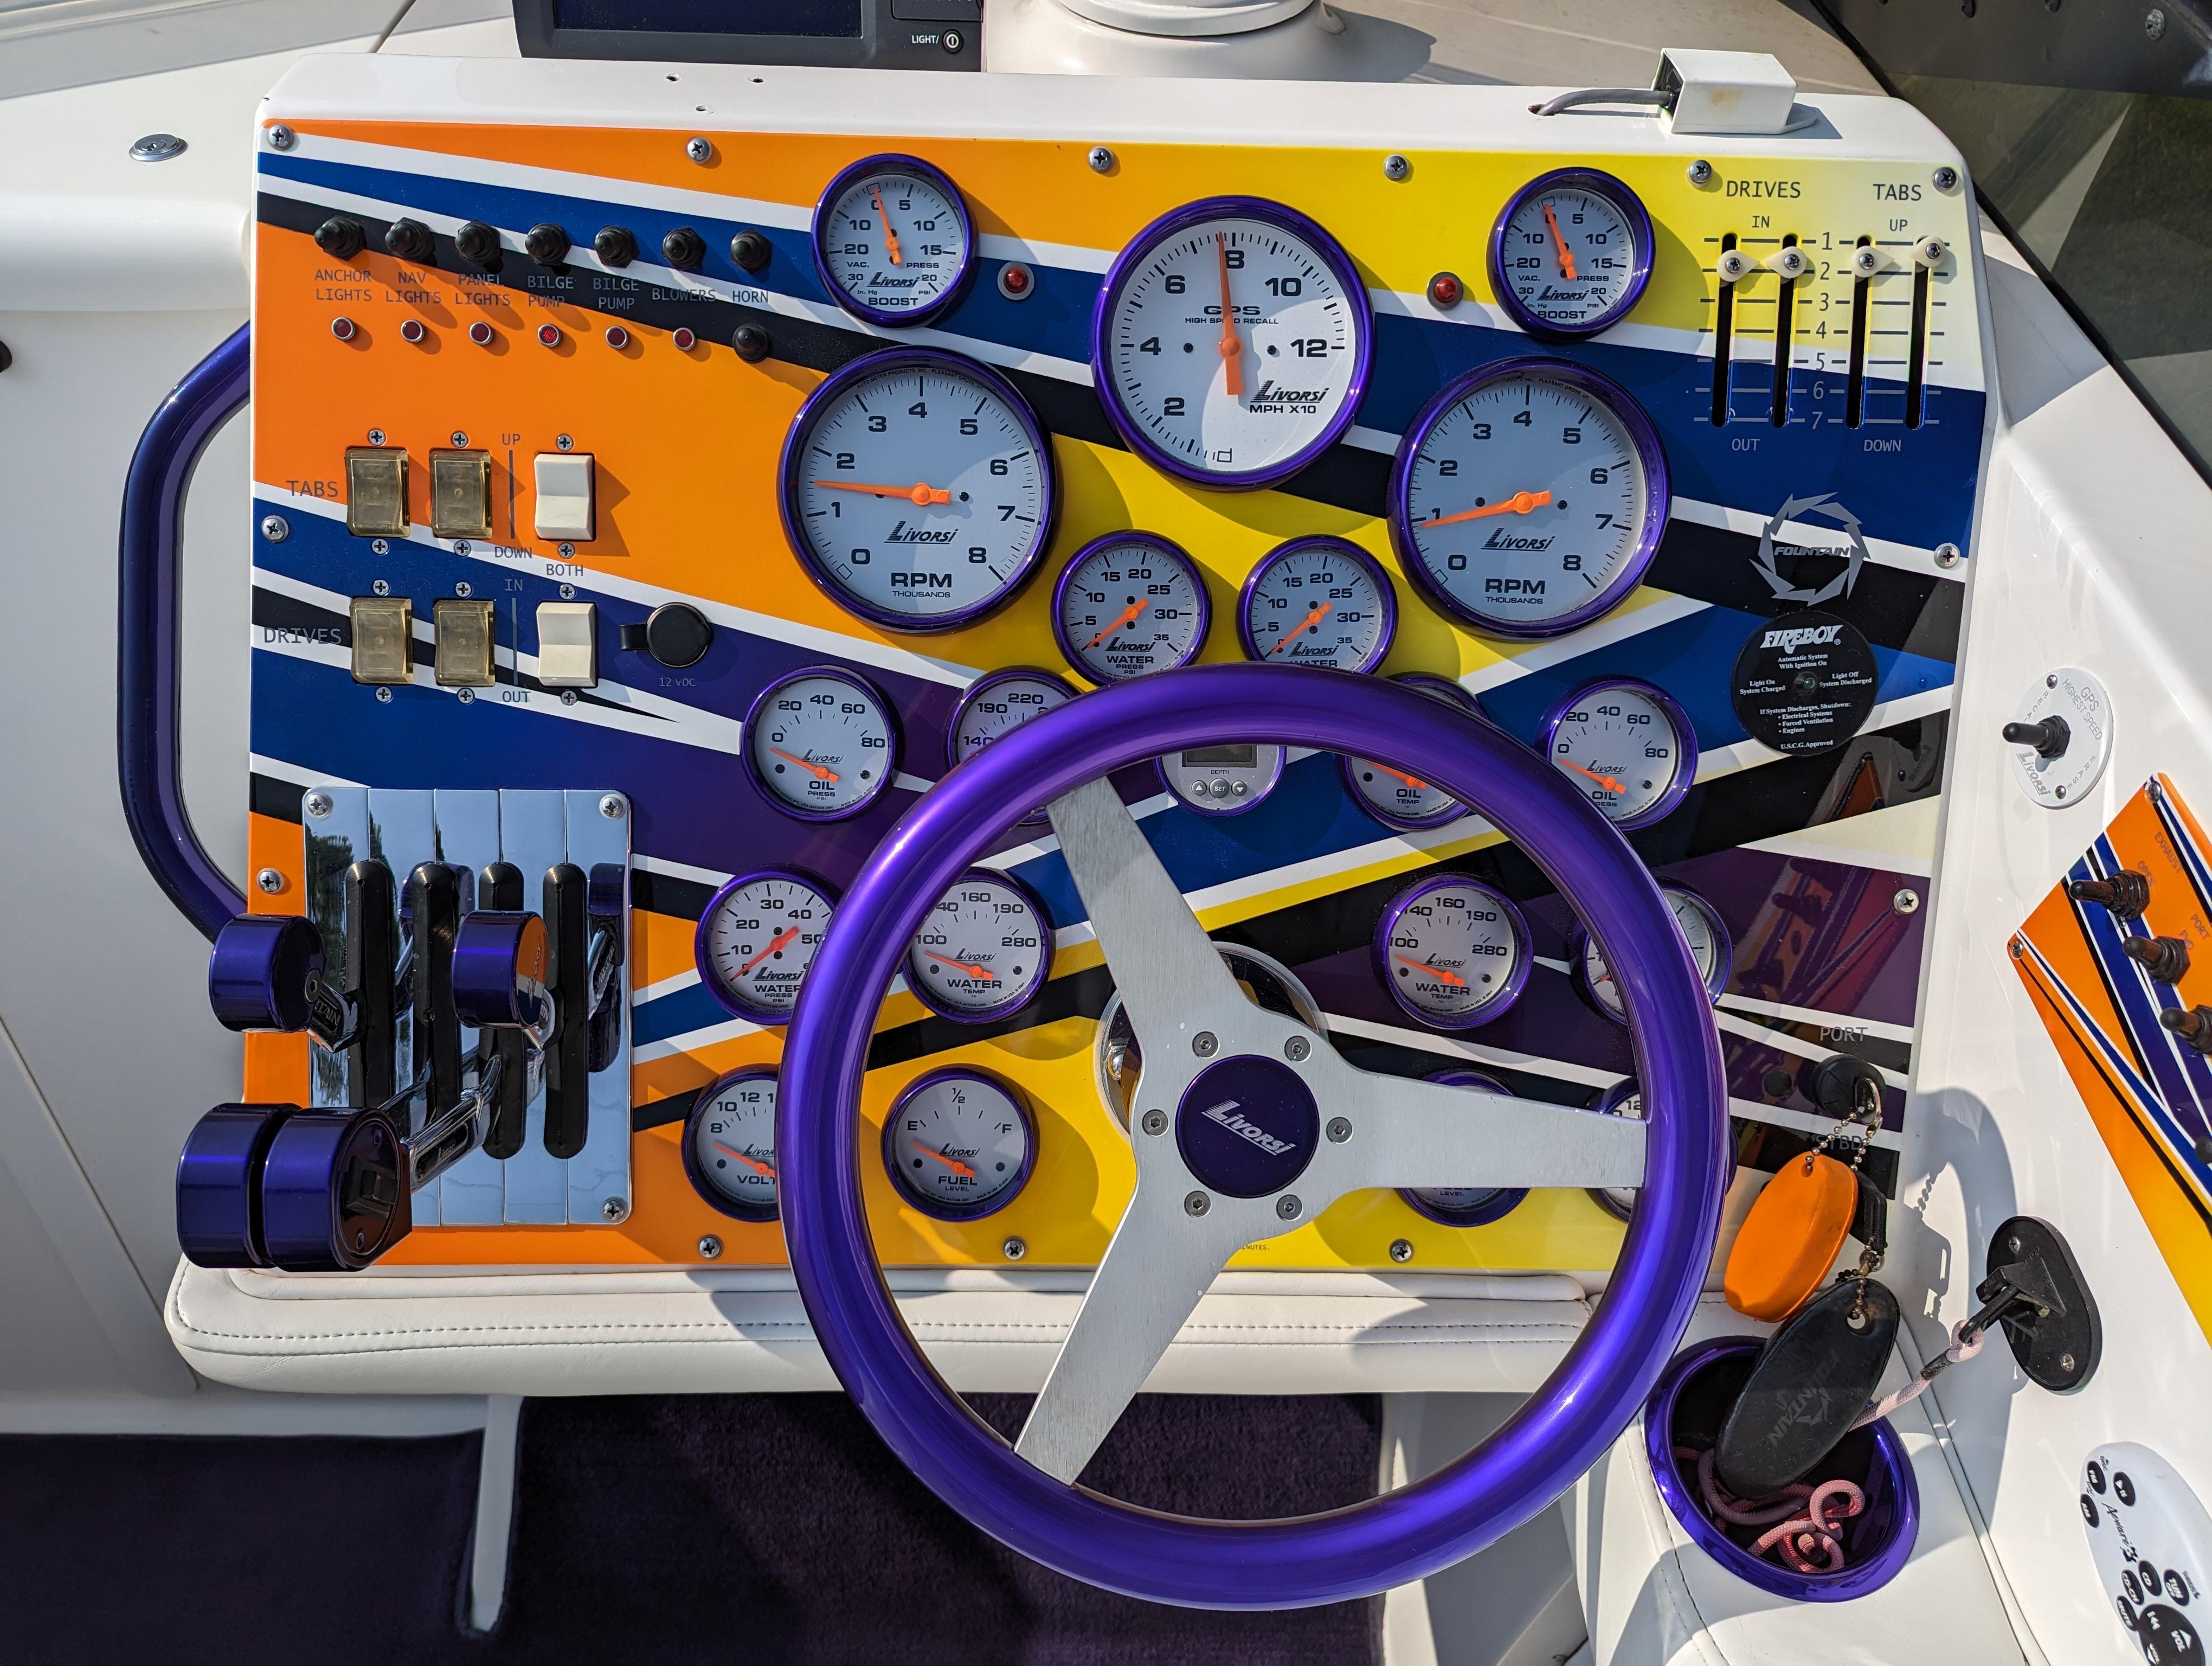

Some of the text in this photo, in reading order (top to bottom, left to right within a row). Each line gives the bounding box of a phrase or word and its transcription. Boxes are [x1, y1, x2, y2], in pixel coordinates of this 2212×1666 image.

[1726, 181, 1801, 198] DRIVES
[1873, 184, 1922, 201] TABS
[849, 220, 871, 230] 10
[914, 221, 935, 230] 10
[1752, 216, 1770, 228] IN
[1889, 219, 1908, 232] UP
[1522, 234, 1544, 244] 10
[1585, 234, 1606, 244] 10
[845, 245, 869, 254] 20
[920, 245, 942, 255] 15
[1516, 258, 1540, 268] 20
[1591, 258, 1612, 268] 15
[315, 269, 371, 283] ANCHOR
[398, 271, 426, 284] NAV
[459, 274, 504, 286] PANEL
[528, 276, 574, 289] BILGE
[593, 278, 639, 291] BILGE
[1265, 278, 1301, 297] 10
[316, 289, 372, 302] LIGHTS
[385, 290, 441, 304] LIGHTS
[455, 293, 511, 306] LIGHTS
[529, 295, 565, 307] PUMP
[652, 288, 716, 302] BLOWERS
[732, 291, 768, 303] HORN
[599, 297, 634, 309] PUMP
[1204, 306, 1261, 315] GPS
[1291, 339, 1327, 357] 12
[857, 380, 870, 389] AUTO
[1250, 405, 1316, 414] MPH X10
[503, 433, 520, 445] UP
[1731, 439, 1760, 451] OUT
[1864, 440, 1901, 452] DOWN
[286, 480, 338, 498] TABS
[494, 547, 532, 559] DOWN
[1774, 547, 1849, 556] FOUNTAIN
[546, 564, 583, 576] BOTH
[1128, 569, 1152, 579] 20
[891, 573, 951, 588] RPM
[1101, 572, 1120, 582] 15
[1283, 578, 1302, 587] 15
[1310, 573, 1333, 583] 20
[505, 579, 523, 591] IN
[1147, 585, 1171, 595] 25
[1485, 579, 1545, 594] RPM
[1329, 588, 1352, 598] 25
[1155, 610, 1177, 619] 30
[1337, 612, 1360, 622] 30
[265, 627, 342, 644] DRIVES
[1760, 625, 1843, 654] FIREBOY
[659, 677, 696, 686] 12 VDC
[1841, 677, 1872, 685] Discharged
[502, 691, 531, 702] OUT
[810, 695, 834, 705] 40
[1008, 694, 1044, 704] 220
[2081, 687, 2099, 712] GPS
[779, 700, 801, 711] 20
[978, 703, 1007, 713] 190
[2062, 678, 2102, 740] HIGHEST SPEED
[2067, 755, 2096, 790] ERASE
[809, 781, 834, 790] OIL
[1397, 789, 1421, 798] OIL
[1592, 791, 1617, 800] OIL
[2155, 831, 2182, 874] EXHAUST
[2138, 861, 2155, 887] OPEN
[961, 892, 991, 902] 160
[1436, 898, 1464, 908] 160
[993, 904, 1024, 914] 190
[1466, 911, 1496, 921] 190
[2190, 914, 2210, 939] PORT
[917, 935, 947, 945] 100
[1002, 937, 1036, 947] 280
[1472, 944, 1507, 956] 280
[947, 979, 1002, 989] WATER
[1416, 983, 1470, 995] WATER
[1820, 1027, 1868, 1042] PORT
[938, 1176, 977, 1185] FUEL
[2081, 1503, 2091, 1518] AM
[2142, 1572, 2152, 1586] CD
[2171, 1630, 2185, 1652] VOL
